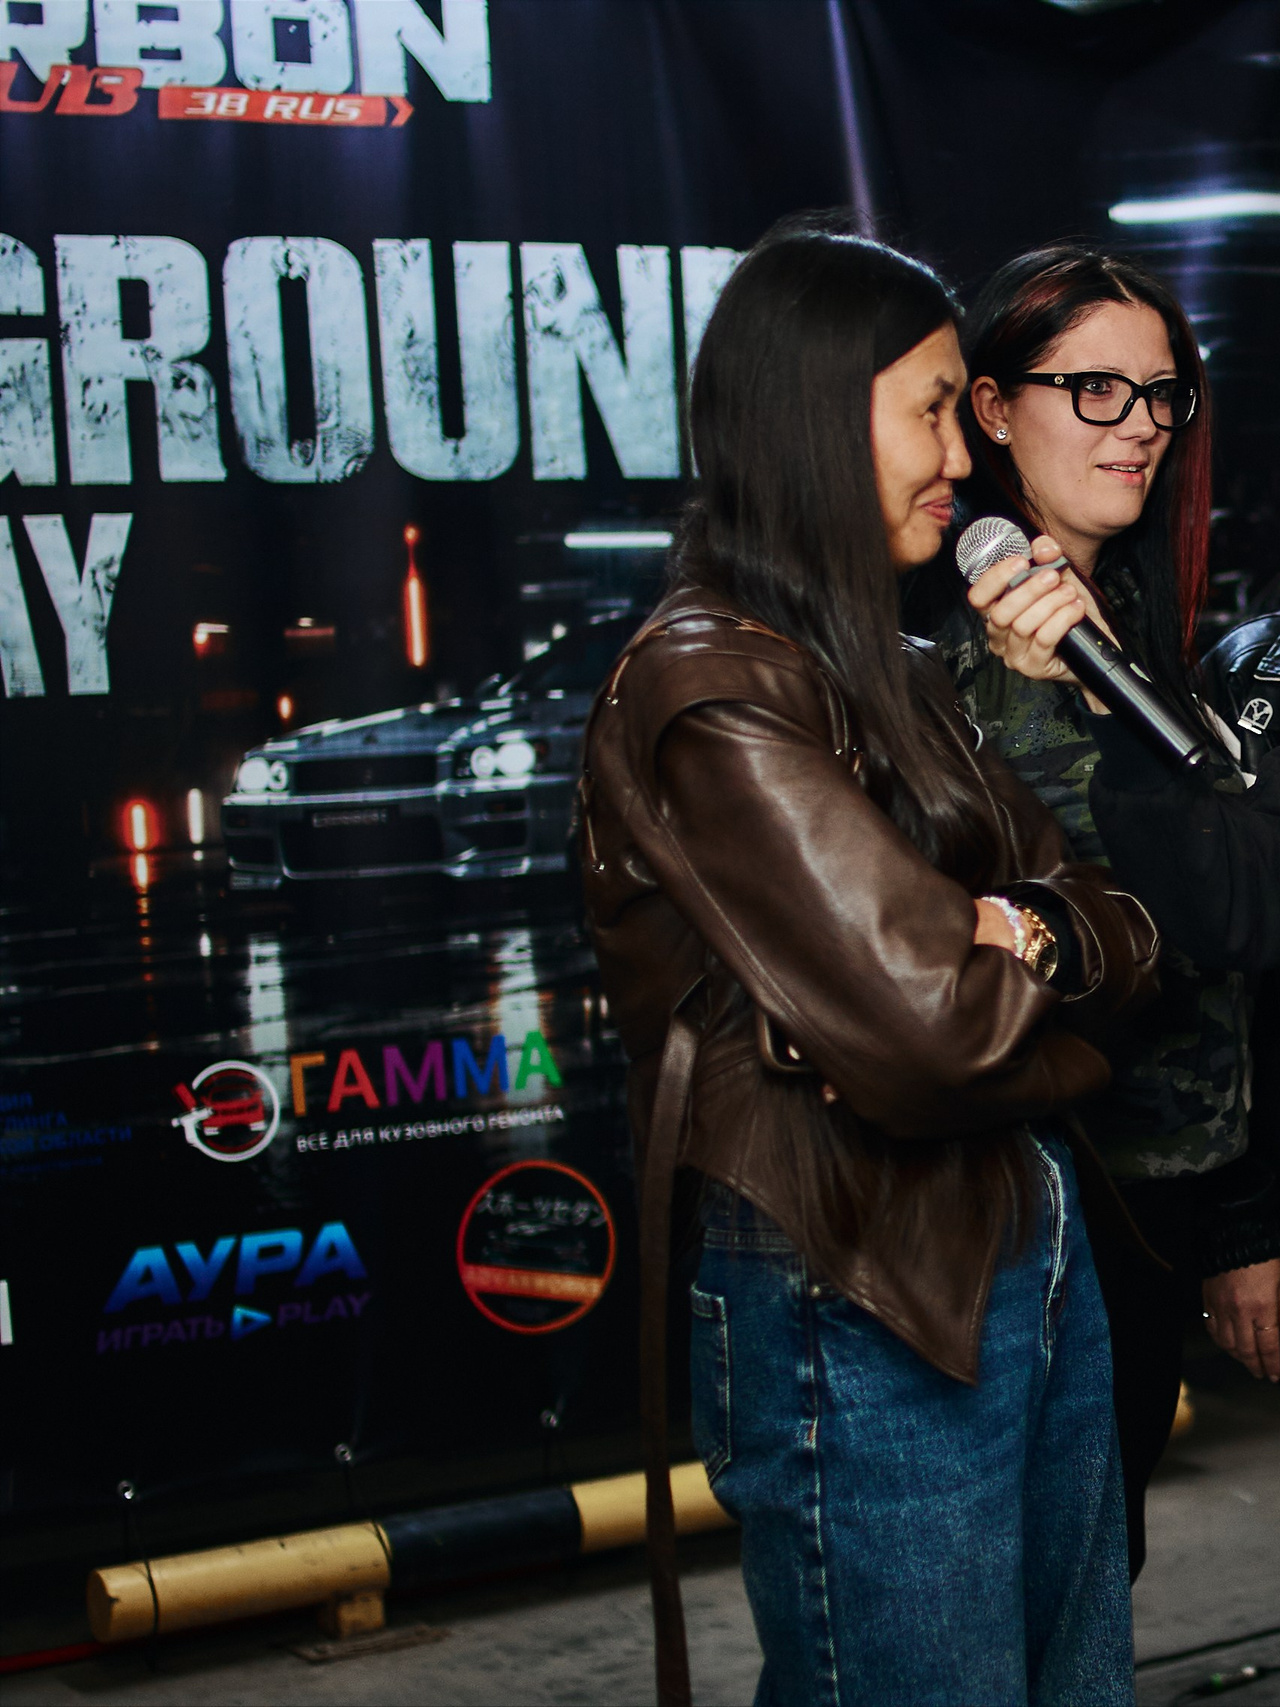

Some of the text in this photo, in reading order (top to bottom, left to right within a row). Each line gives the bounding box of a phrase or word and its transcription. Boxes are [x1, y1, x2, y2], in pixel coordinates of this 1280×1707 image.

[184, 92, 365, 122] 38 RUS
[289, 1030, 563, 1117] ГАММА
[296, 1104, 565, 1153] ВСЕ ДЛЯ КУЗОВНОГО РЕМОНТА
[101, 1218, 368, 1314] АУРА
[95, 1291, 374, 1355] ИГРАТЬ PLAY
